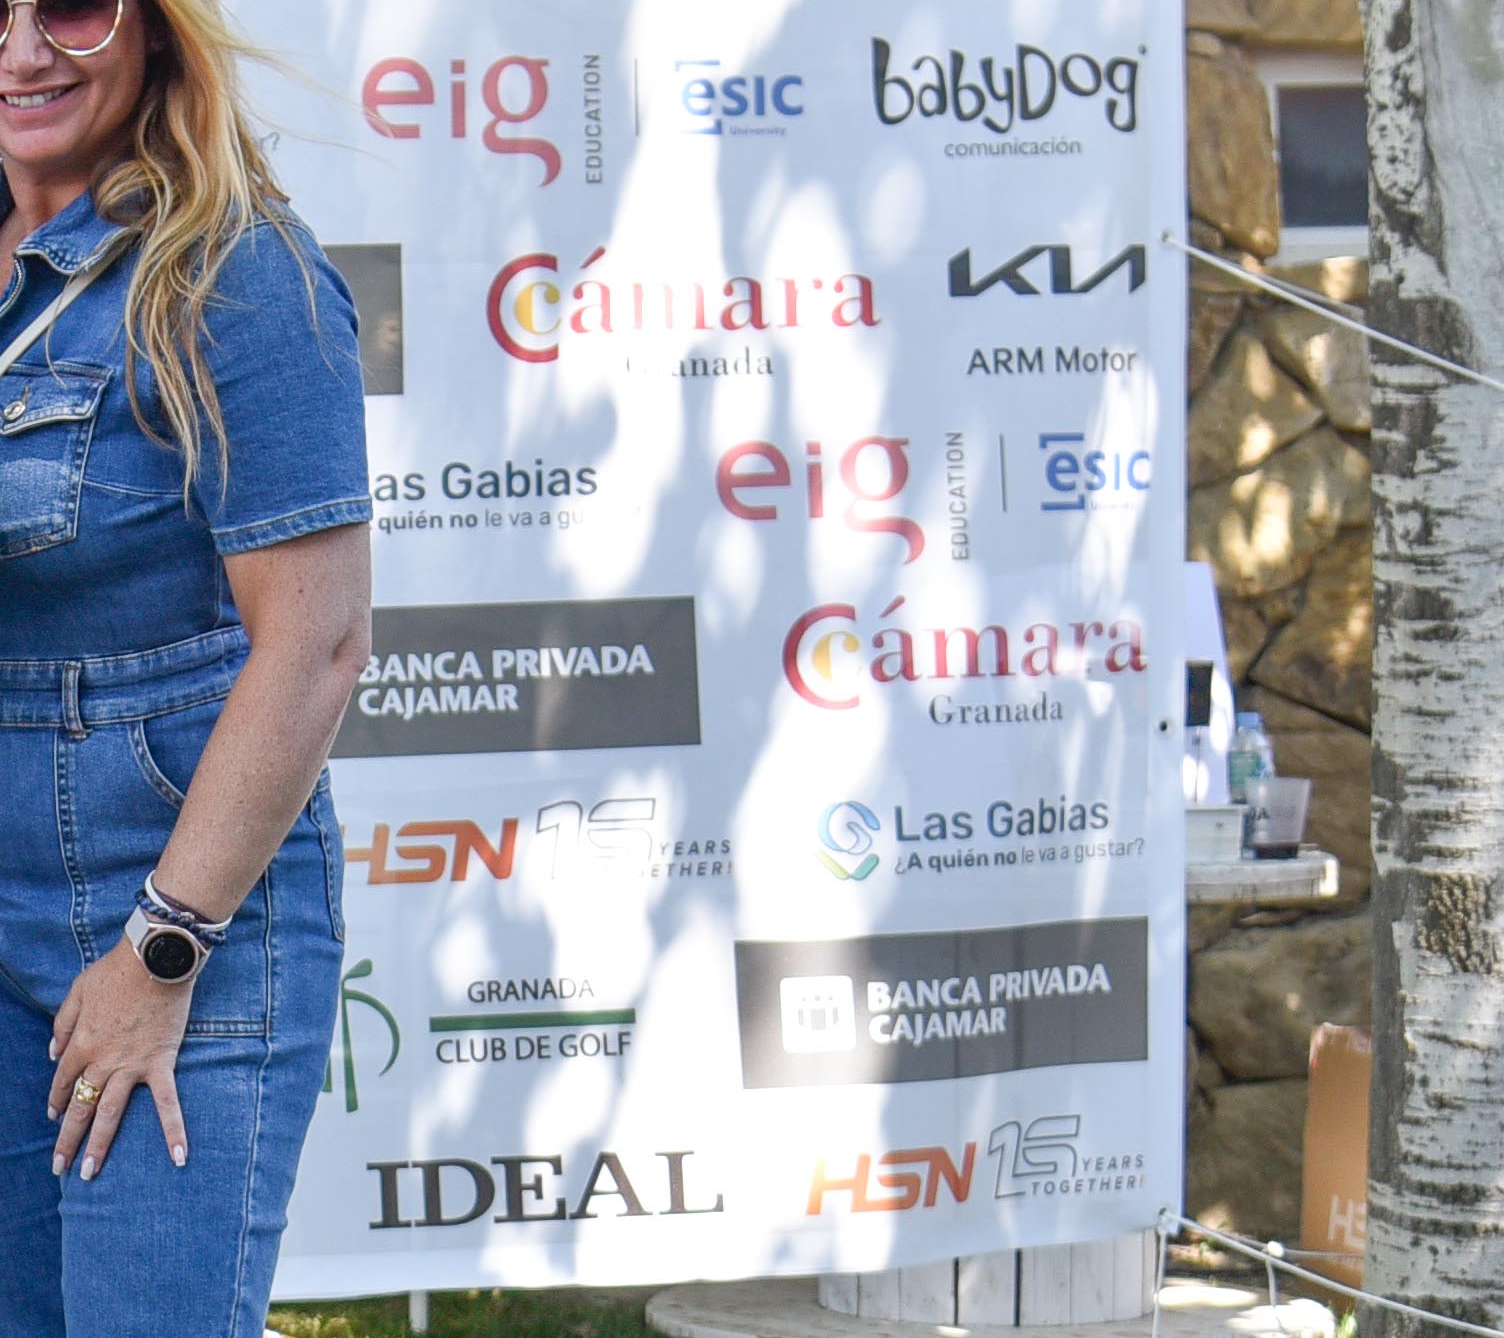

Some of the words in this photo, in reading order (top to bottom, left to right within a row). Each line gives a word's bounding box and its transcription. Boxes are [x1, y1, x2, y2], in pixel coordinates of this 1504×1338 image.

[361, 53, 562, 188] eig
[585, 53, 603, 185] EDUCATION
[943, 137, 1082, 158] comunicación
[967, 346, 1047, 377] ARM
[1055, 346, 1137, 374] Motor
[441, 459, 598, 501] Gabias
[950, 430, 970, 562] EDUCATION
[715, 434, 926, 566] eig
[378, 510, 443, 535] quién
[449, 511, 478, 529] no
[485, 509, 502, 528] le
[509, 510, 532, 527] va
[539, 511, 551, 526] a
[359, 651, 483, 684] BANCA
[492, 644, 655, 679] PRIVADA
[358, 683, 519, 720] CAJAMAR
[928, 692, 1064, 727] Granada
[894, 805, 974, 842] Las
[987, 795, 1109, 838] Gabias
[659, 838, 732, 856] YEARS
[929, 848, 989, 873] quién
[994, 850, 1018, 867] no
[1021, 847, 1035, 863] le
[1038, 845, 1056, 861] va
[1060, 846, 1070, 859] a
[1074, 838, 1145, 863] gustar?
[467, 978, 595, 1004] GRANADA
[867, 978, 982, 1014] BANCA
[989, 964, 1112, 1003] PRIVADA
[867, 1007, 1007, 1045] CAJAMAR
[435, 1034, 510, 1064] CLUB
[514, 1034, 552, 1062] DE
[560, 1031, 633, 1060] GOLF
[805, 1141, 977, 1217] HSN
[1081, 1153, 1146, 1173] YEARS
[367, 1150, 725, 1230] IDEAL
[1030, 1173, 1146, 1195] TOGETHER!
